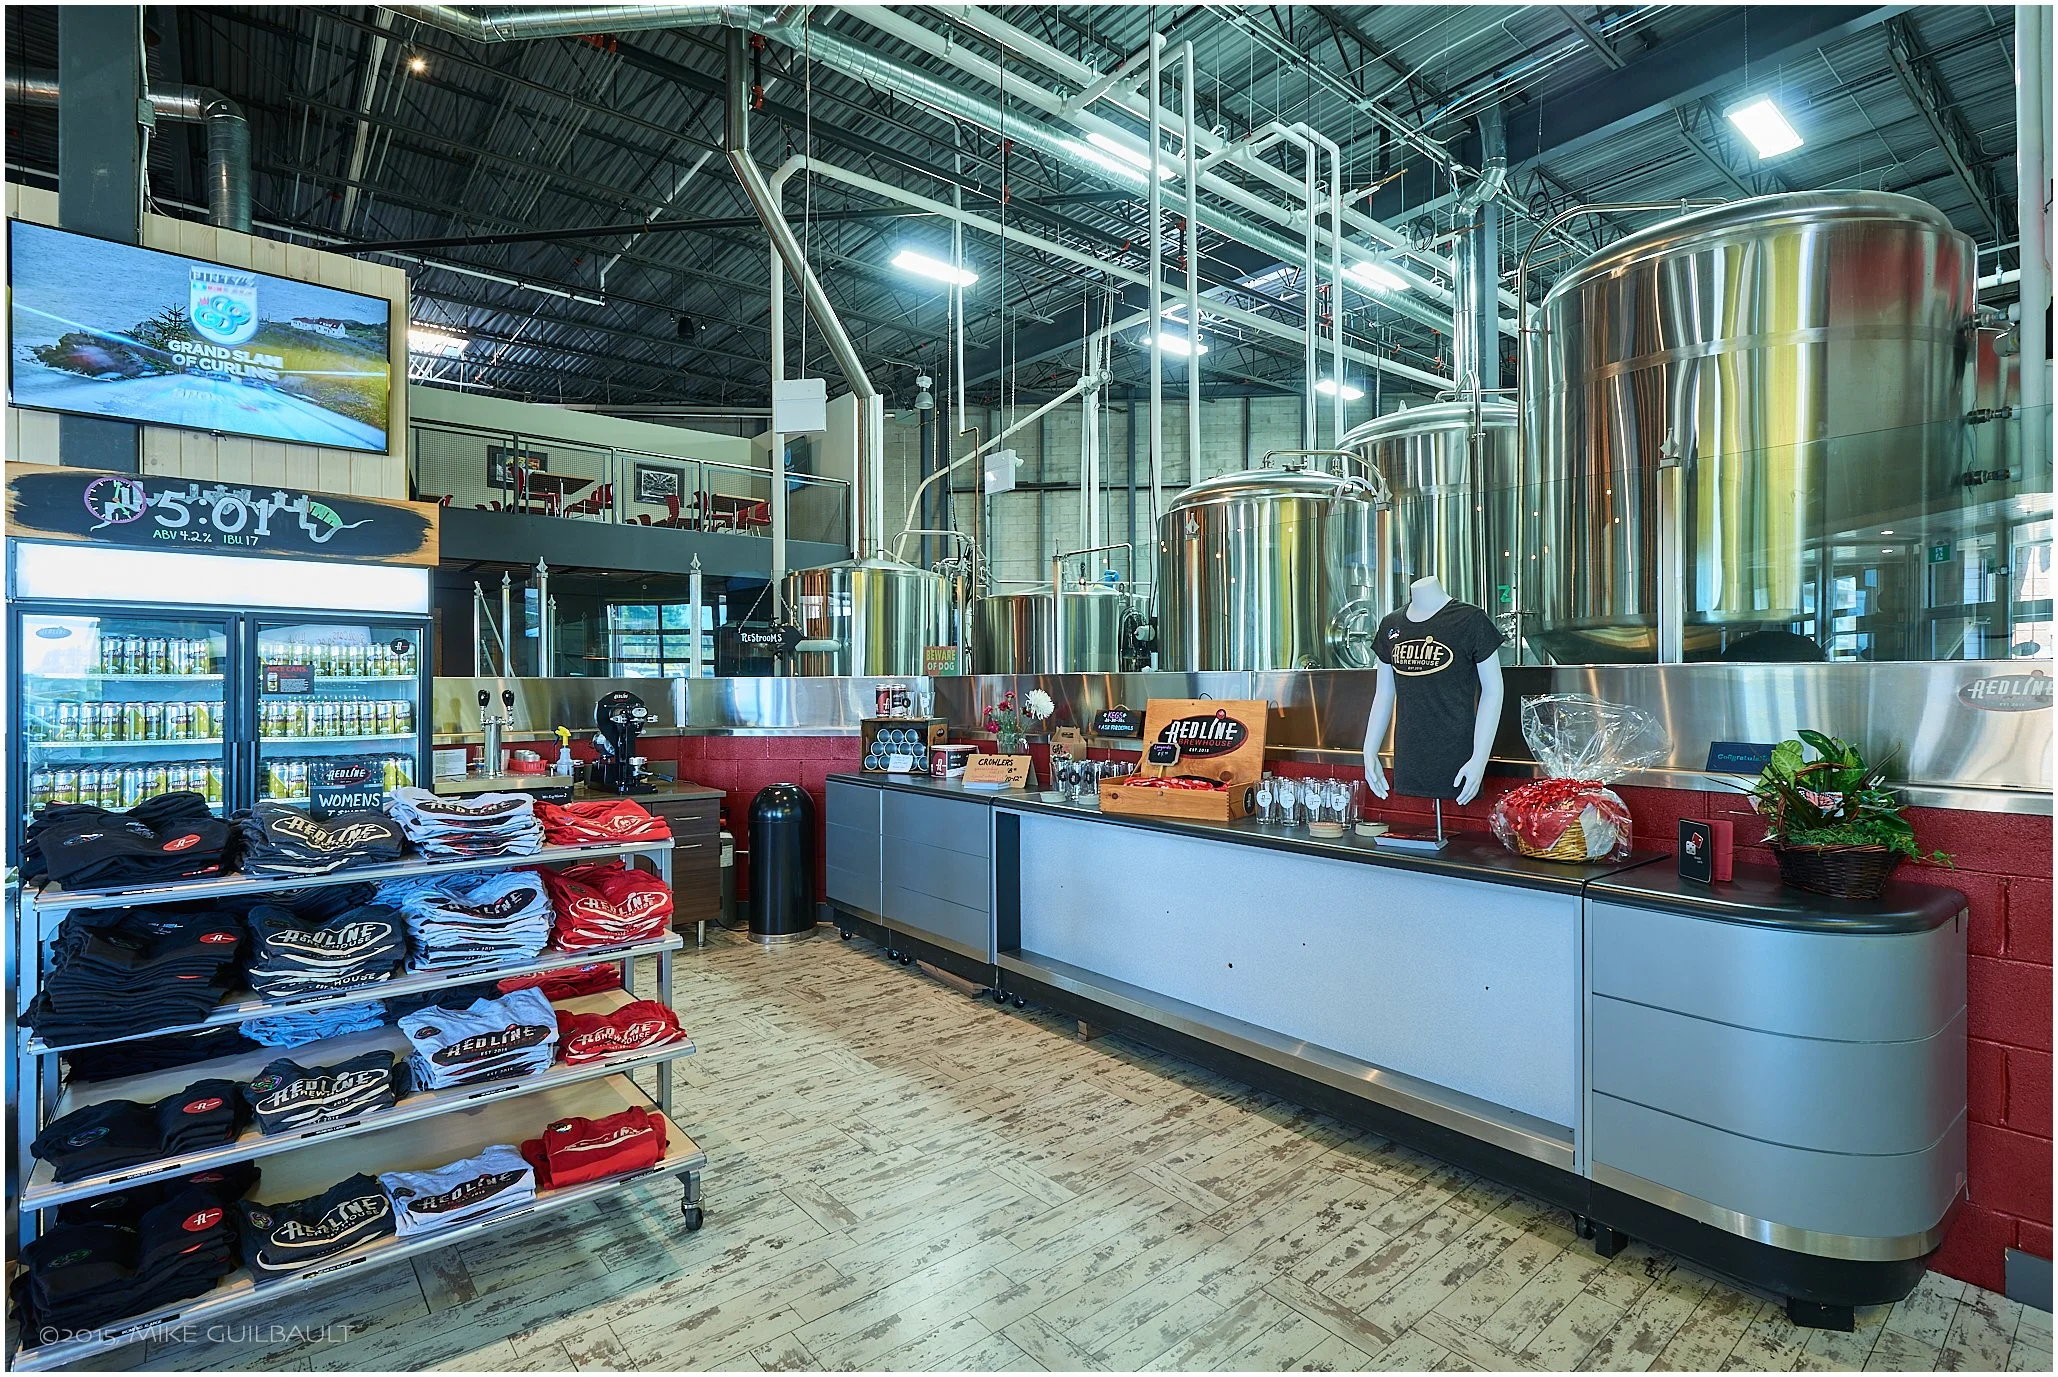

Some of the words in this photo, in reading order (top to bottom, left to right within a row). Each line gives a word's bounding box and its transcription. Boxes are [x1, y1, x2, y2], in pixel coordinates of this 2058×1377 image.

[168, 340, 231, 360] GRAND
[231, 349, 284, 369] SLAM
[171, 353, 197, 368] OF
[199, 357, 280, 382] CURLING
[154, 489, 271, 536] 5:01
[153, 529, 177, 541] ABV
[223, 534, 243, 546] IBU
[245, 535, 259, 546] 17
[926, 649, 956, 661] BEWARE
[1392, 641, 1445, 664] REDLINE
[927, 662, 938, 671] OF
[938, 661, 955, 671] DOG
[1400, 659, 1440, 667] BREWHOUSE
[1967, 676, 2053, 699] REDLINE
[1107, 711, 1123, 719] KEGS
[1164, 717, 1238, 744] REDLINE
[1178, 738, 1233, 748] BREWHOUSE
[978, 758, 1014, 767] CROWLERS
[326, 767, 366, 781] REDLINE
[319, 792, 381, 808] WOMENS
[442, 1025, 537, 1058] REDLINE
[416, 1173, 513, 1210] REDLINE
